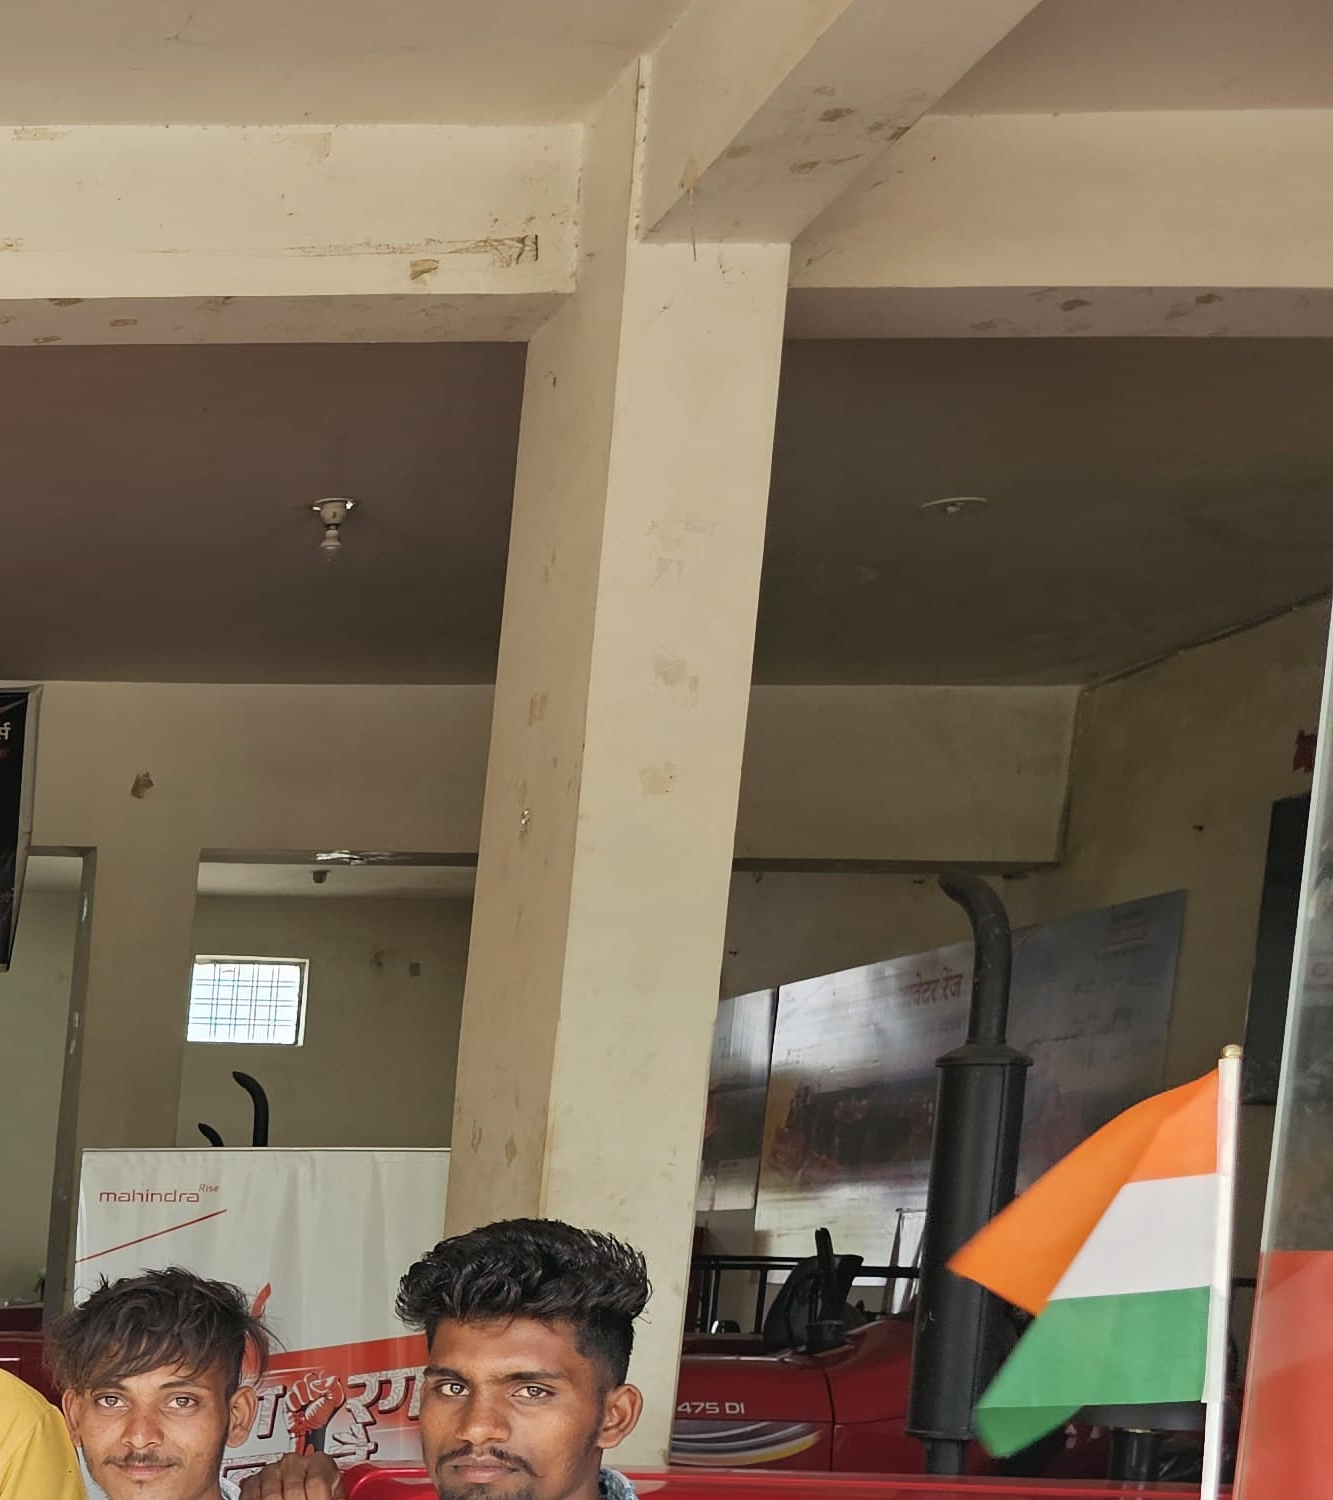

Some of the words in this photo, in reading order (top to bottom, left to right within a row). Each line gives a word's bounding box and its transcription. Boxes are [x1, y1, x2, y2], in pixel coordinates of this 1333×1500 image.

[99, 1189, 200, 1203] mahindra
[199, 1183, 220, 1193] Rise
[725, 1402, 745, 1415] DI
